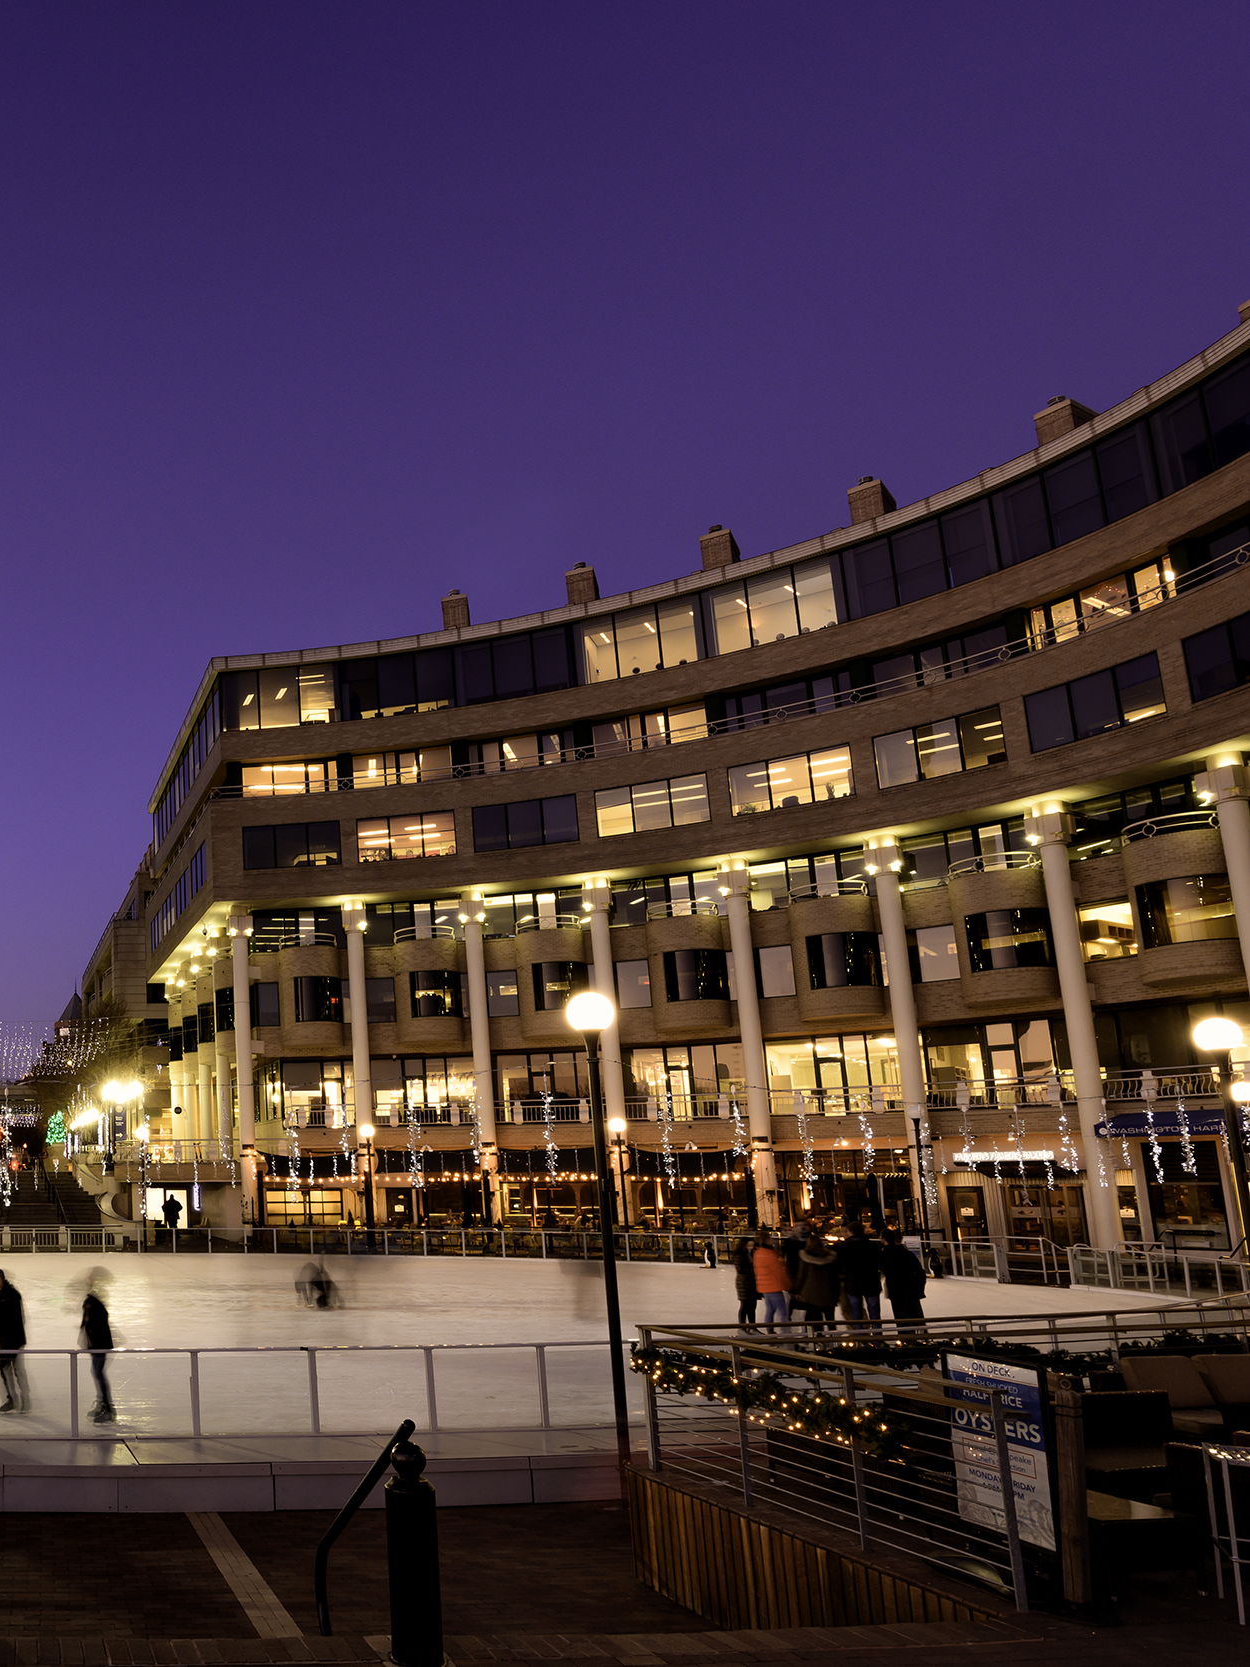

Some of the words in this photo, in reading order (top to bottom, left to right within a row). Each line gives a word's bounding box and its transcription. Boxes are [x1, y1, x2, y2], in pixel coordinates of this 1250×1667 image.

[1192, 1124, 1228, 1132] HARB
[971, 1362, 985, 1372] ON
[1000, 1393, 1023, 1408] RICE
[954, 1407, 1042, 1444] OYSERS
[1012, 1480, 1036, 1493] RIDAY
